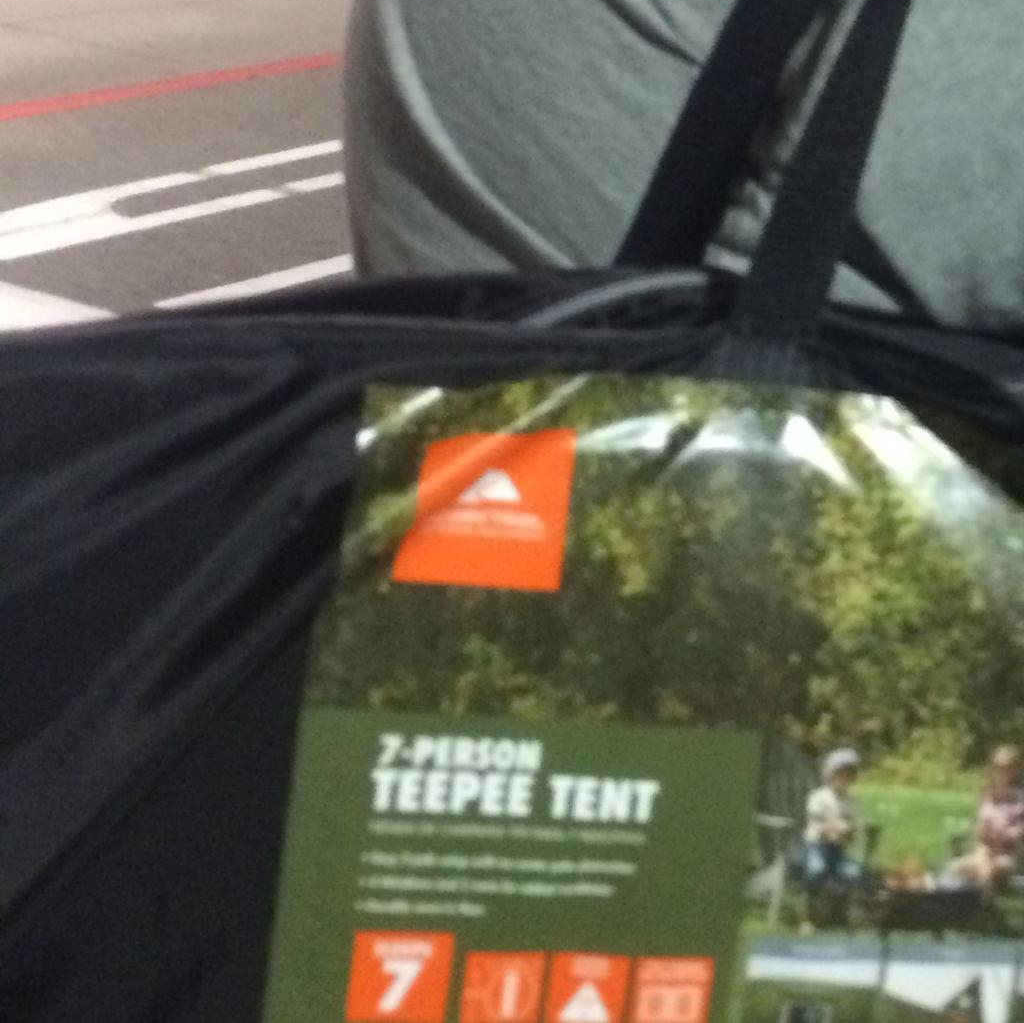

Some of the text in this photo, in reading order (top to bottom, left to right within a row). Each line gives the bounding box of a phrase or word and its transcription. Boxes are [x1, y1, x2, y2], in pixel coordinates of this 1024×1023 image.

[377, 733, 544, 770] 7-PERSON
[371, 768, 661, 824] TEEPEE TENT
[378, 958, 423, 1014] 7
